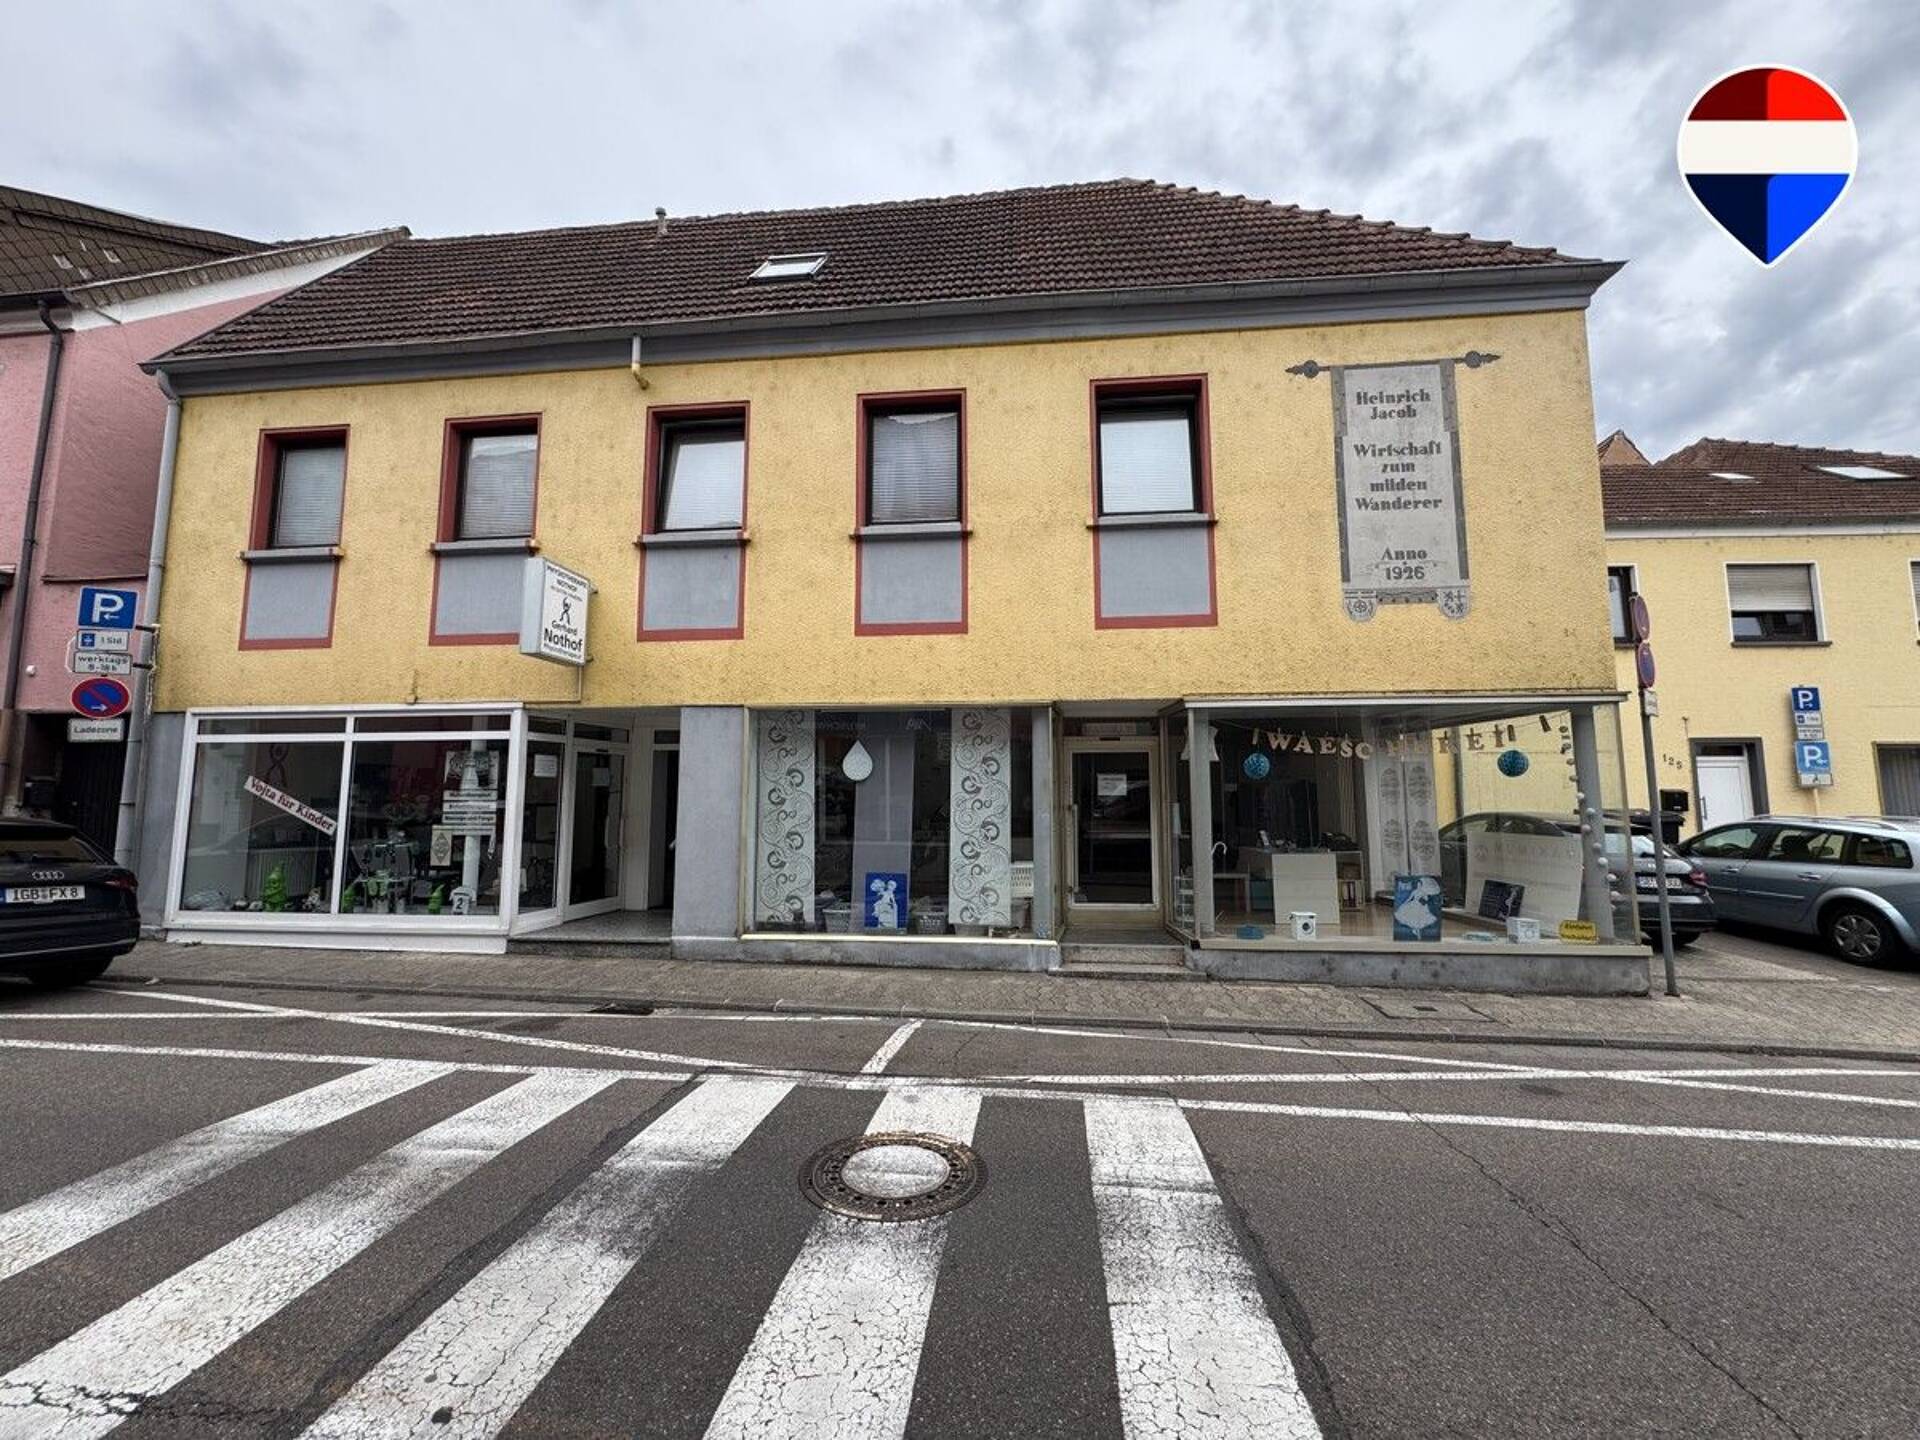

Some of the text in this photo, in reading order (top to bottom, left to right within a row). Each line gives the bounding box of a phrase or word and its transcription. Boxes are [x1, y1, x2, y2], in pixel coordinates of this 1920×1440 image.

[1355, 388, 1431, 405] Heinrich
[1370, 405, 1417, 420] Jacob
[1354, 441, 1442, 458] Wirtschaft
[1381, 461, 1415, 473] zum
[1369, 477, 1427, 493] milden
[1355, 496, 1442, 512] Wanderer
[1381, 547, 1428, 561] Anno
[1385, 566, 1425, 580] 1926
[92, 592, 124, 623] P
[543, 627, 583, 652] Nothof
[78, 655, 128, 665] werktags
[1797, 690, 1813, 709] P
[1803, 745, 1822, 767] P
[251, 776, 333, 830] Vojta für Kinder
[13, 887, 78, 901] IGB FX 8
